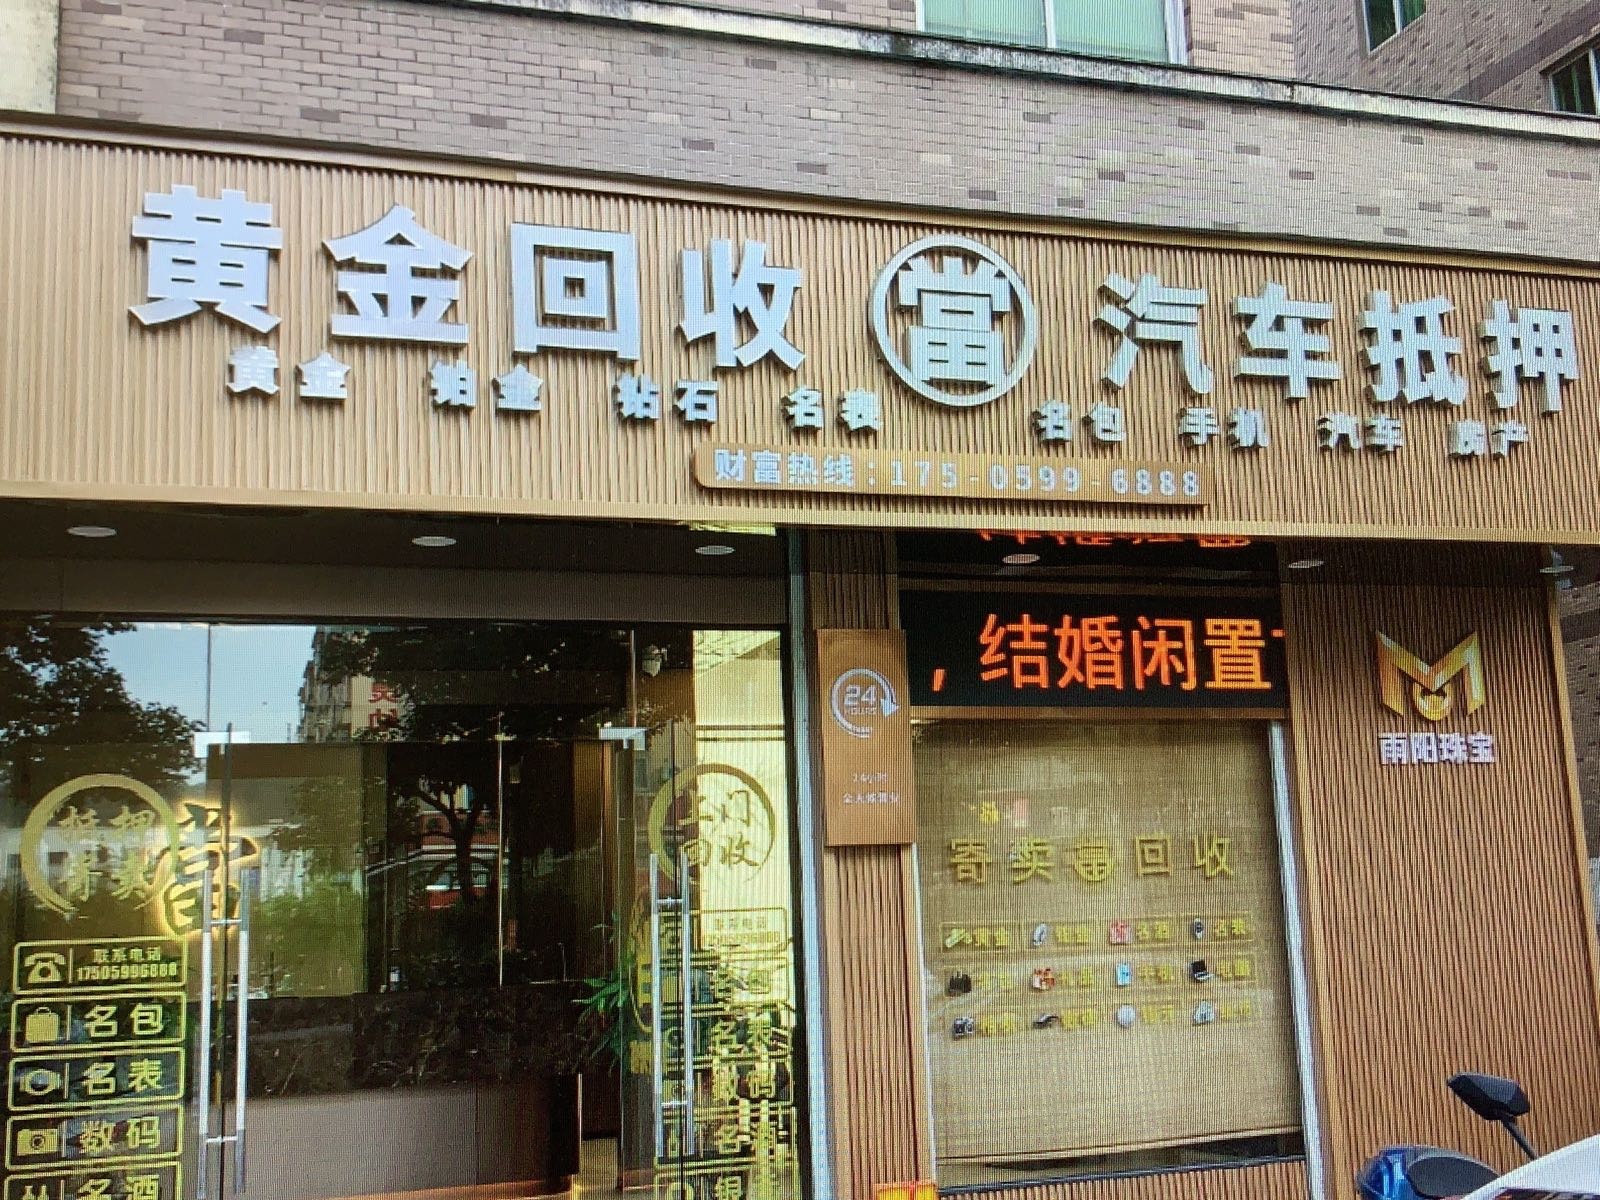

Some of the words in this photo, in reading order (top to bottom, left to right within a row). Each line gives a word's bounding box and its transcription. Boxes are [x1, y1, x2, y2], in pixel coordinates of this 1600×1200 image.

[130, 185, 806, 370] 黄金回收
[1095, 273, 1579, 413] 汽车抵押
[228, 345, 351, 399] 黄金
[430, 360, 543, 411] 铂金
[617, 372, 719, 423] 钻石
[783, 385, 882, 431] 名表
[1036, 401, 1127, 442] 名包
[1180, 407, 1269, 448] 手机
[1319, 412, 1403, 451] 汽车
[844, 685, 877, 706] 24
[77, 962, 177, 981] 17505996888
[94, 947, 161, 964] 联系电话
[84, 1003, 164, 1038] 名包
[82, 1058, 163, 1096] 名表
[80, 1115, 161, 1154] 数码
